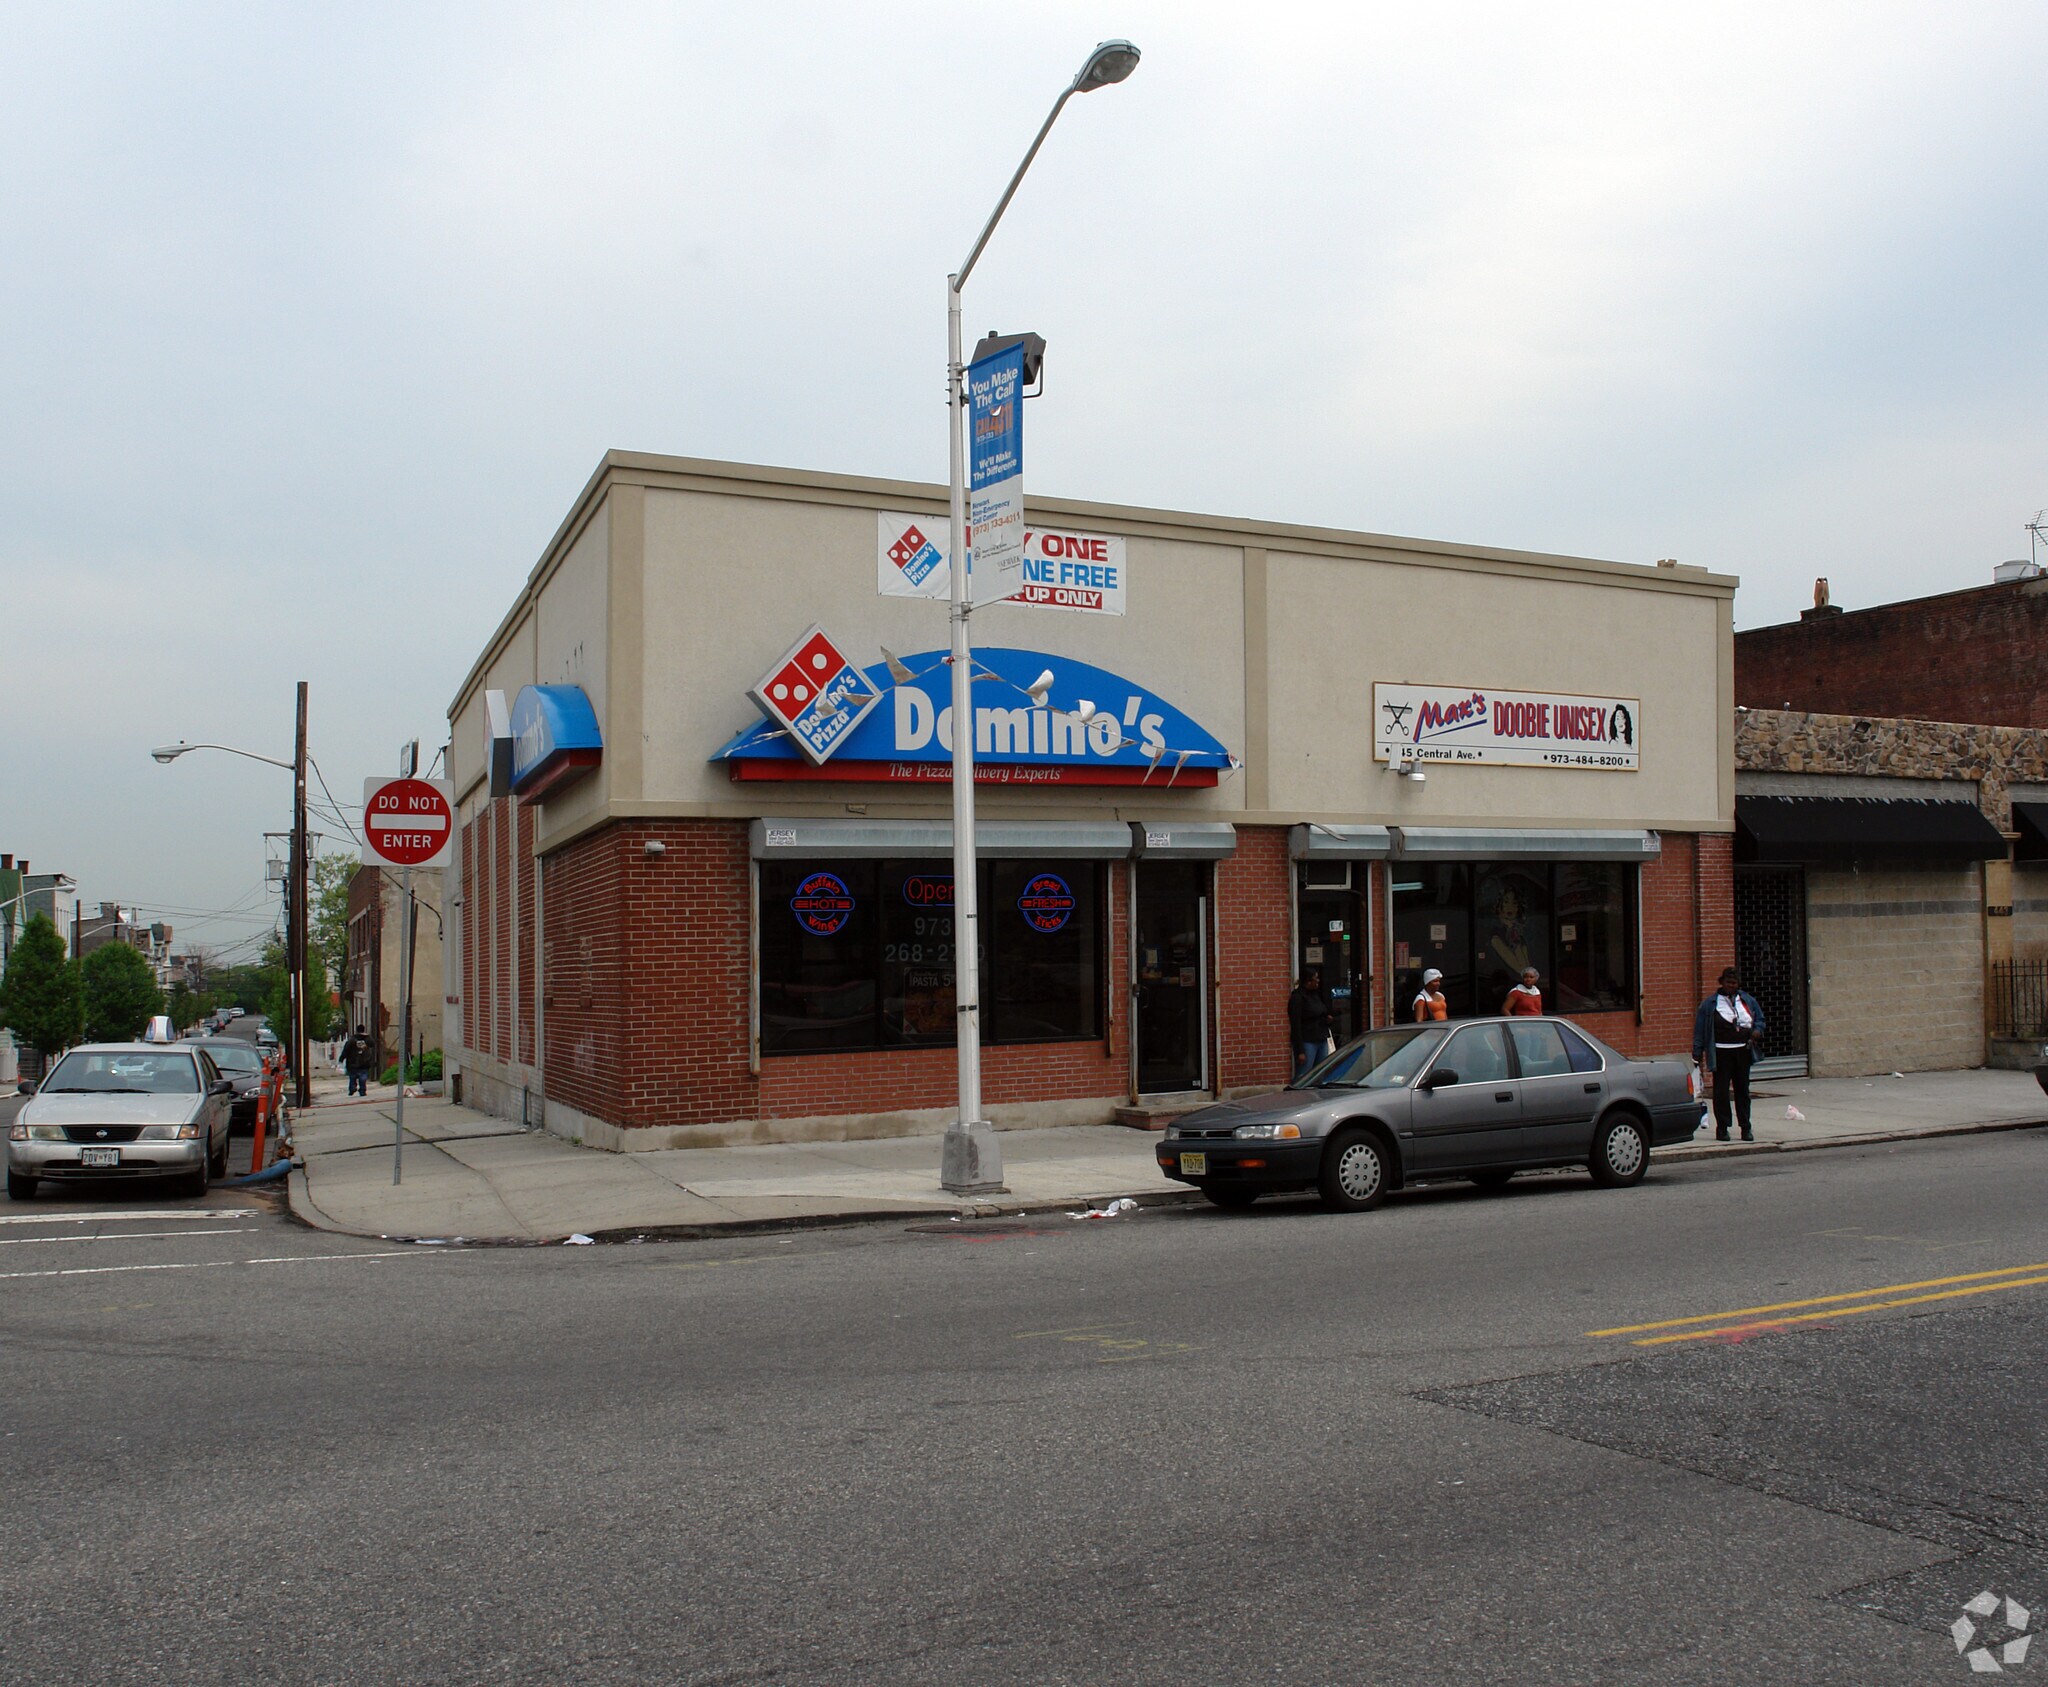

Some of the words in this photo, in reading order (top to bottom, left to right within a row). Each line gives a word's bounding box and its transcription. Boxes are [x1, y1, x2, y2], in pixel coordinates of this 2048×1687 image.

[971, 381, 990, 396] You
[991, 368, 1018, 388] Make
[975, 393, 993, 409] The
[995, 381, 1014, 400] Call
[973, 471, 985, 481] The
[986, 459, 1017, 477] Difference
[1041, 534, 1108, 562] ONE
[904, 545, 934, 576] Domino's
[910, 563, 931, 584] Pizza
[1023, 558, 1055, 583] NE
[1060, 563, 1118, 589] FREE
[1055, 589, 1100, 606] ONLY
[797, 675, 857, 736] Doino's
[1413, 692, 1488, 743] Max's
[1493, 700, 1550, 739] DOOBIE
[1553, 704, 1607, 742] UNISEX
[1417, 748, 1452, 759] Central
[1457, 750, 1476, 759] Ave.
[1550, 754, 1624, 766] 973-484-8200
[889, 763, 913, 777] The
[917, 764, 952, 778] Pizza
[973, 764, 1010, 783] livery
[378, 796, 399, 809] DO
[409, 796, 439, 810] NOT
[383, 834, 432, 848] ENTER
[804, 876, 840, 894] Buffalo
[1032, 880, 1061, 891] Bread
[809, 899, 836, 910] HOT
[1032, 898, 1062, 909] FRESH
[809, 915, 839, 932] Wings
[914, 917, 951, 936] 973
[1035, 916, 1062, 928] Sticks
[912, 976, 939, 987] PASTA
